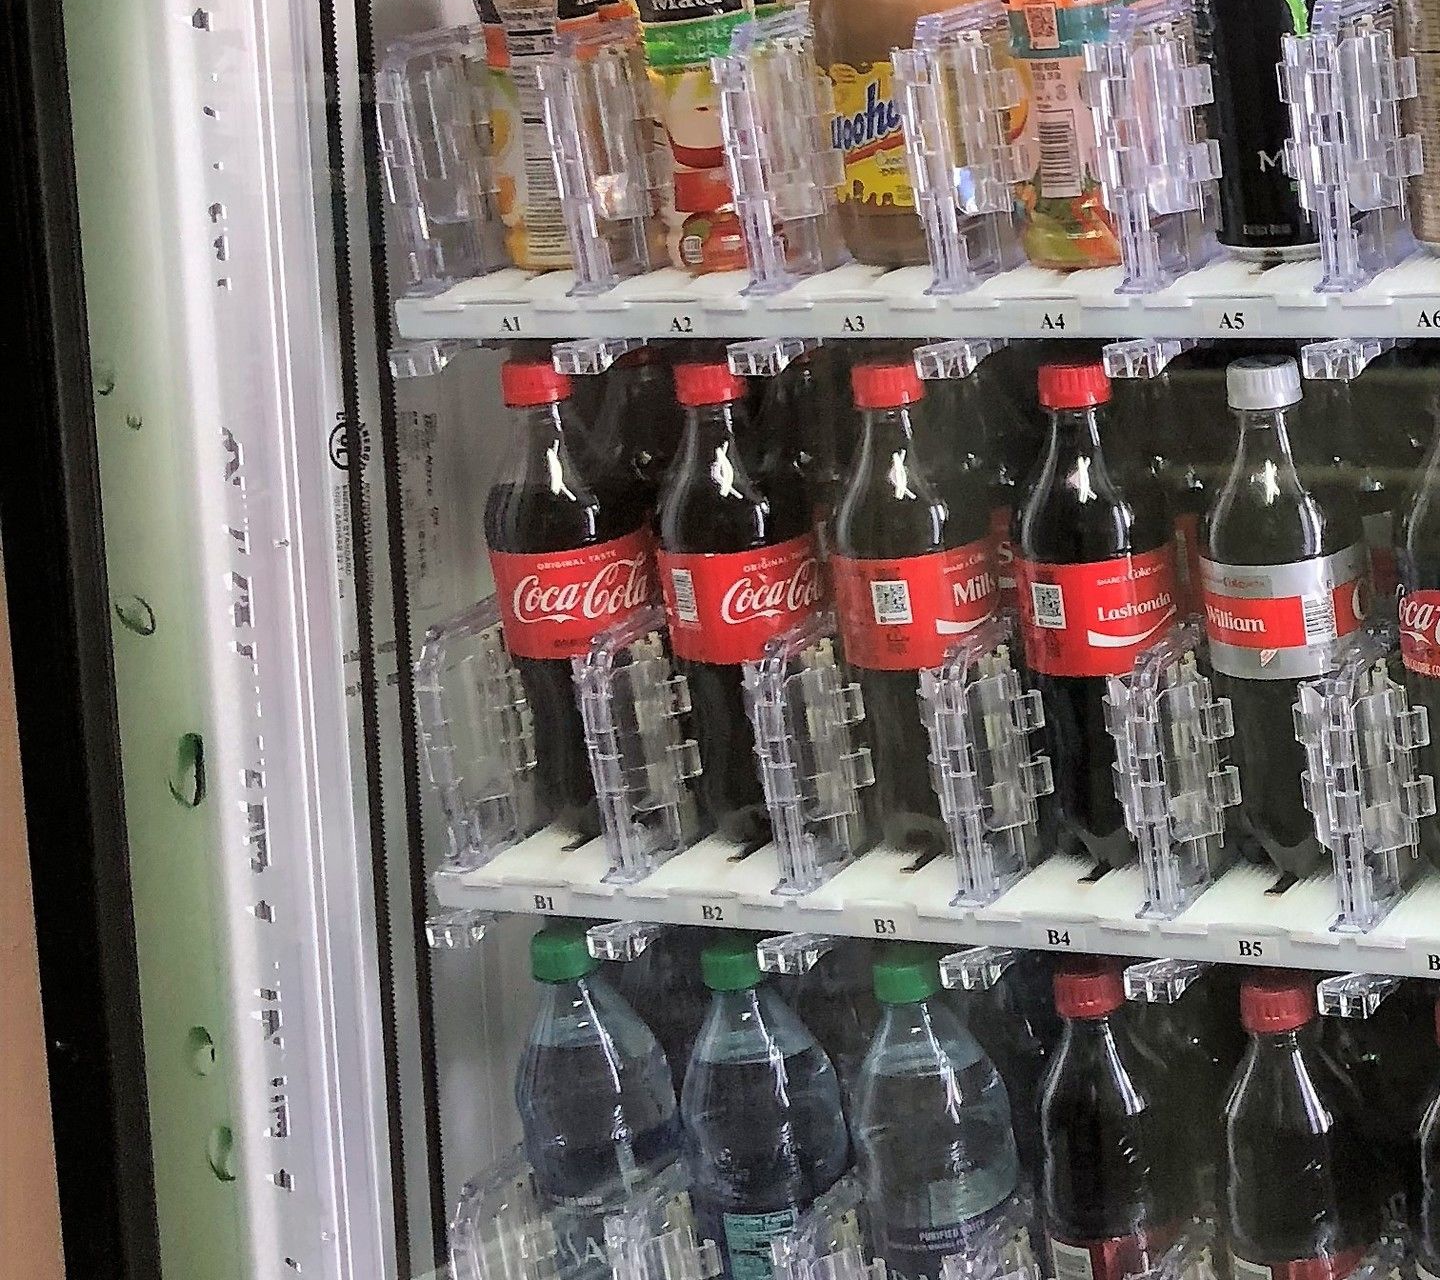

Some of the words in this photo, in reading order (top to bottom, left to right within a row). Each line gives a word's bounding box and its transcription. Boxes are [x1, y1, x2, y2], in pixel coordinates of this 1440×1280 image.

[500, 316, 520, 332] A1
[670, 317, 693, 332] A2
[842, 316, 865, 332] A3
[1040, 313, 1066, 330] A4
[1219, 312, 1245, 330] A5
[537, 559, 585, 571] ORIGINAL
[513, 551, 648, 624] Coca-Cola
[1205, 602, 1267, 632] William
[534, 894, 554, 910] B1
[702, 905, 724, 921] B2
[874, 919, 896, 934] B3
[1047, 929, 1070, 946] B4
[1238, 940, 1263, 957] B5
